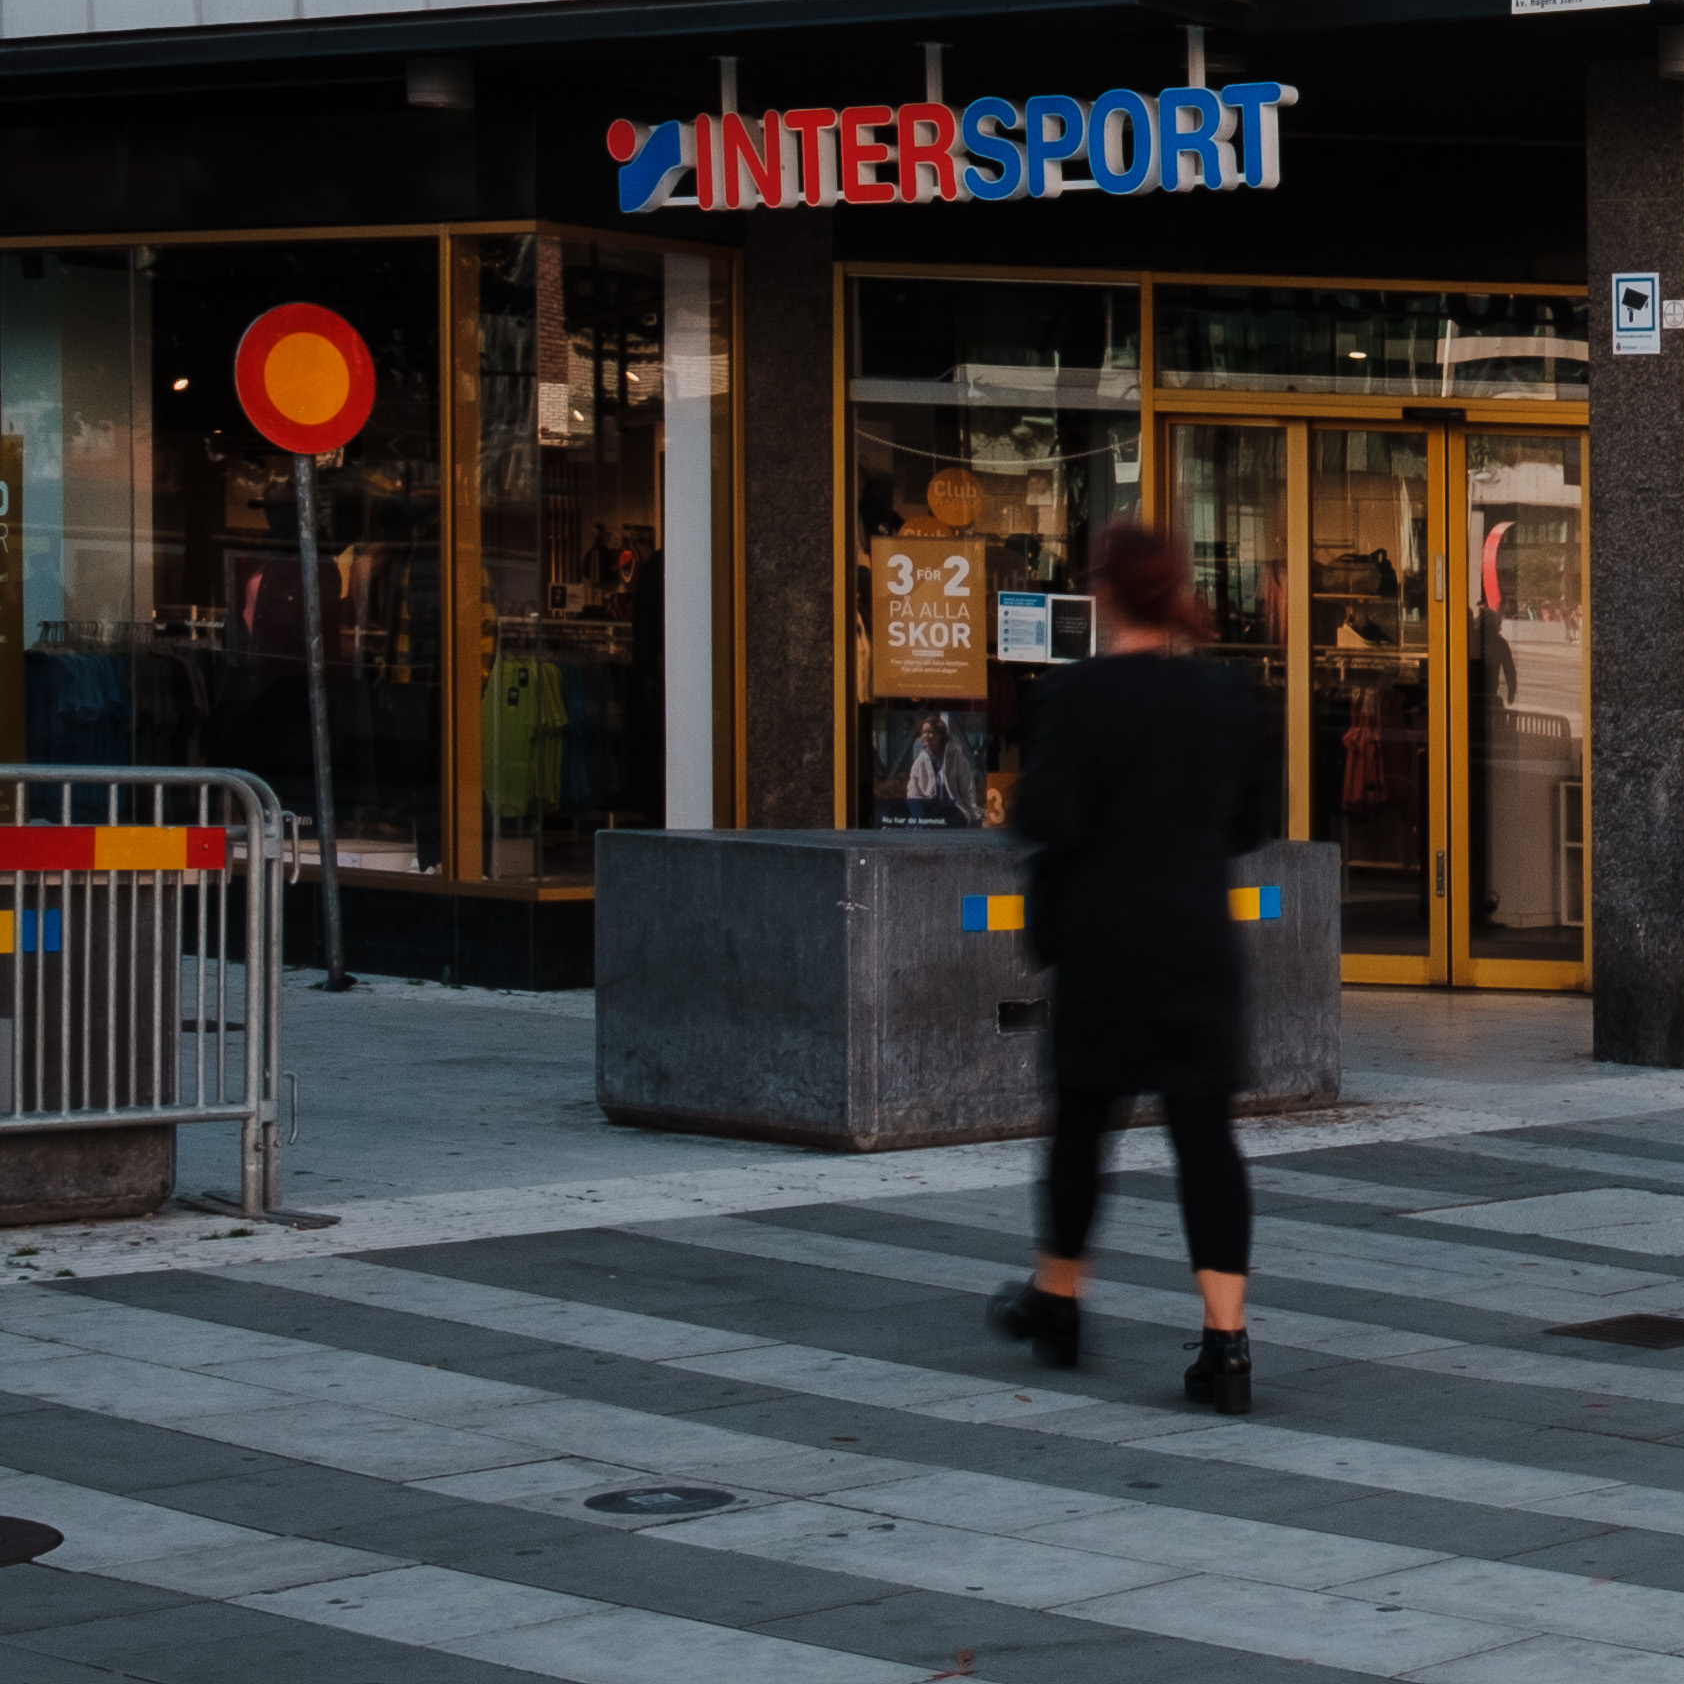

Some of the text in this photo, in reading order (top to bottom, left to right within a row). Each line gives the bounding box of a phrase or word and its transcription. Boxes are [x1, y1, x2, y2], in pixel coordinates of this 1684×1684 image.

[694, 81, 1292, 212] INTERSPORT
[887, 554, 914, 596] 3
[917, 565, 941, 581] FÖR
[943, 555, 971, 597] 2
[889, 596, 971, 620] PÅ ALLA
[887, 622, 972, 649] SKOR
